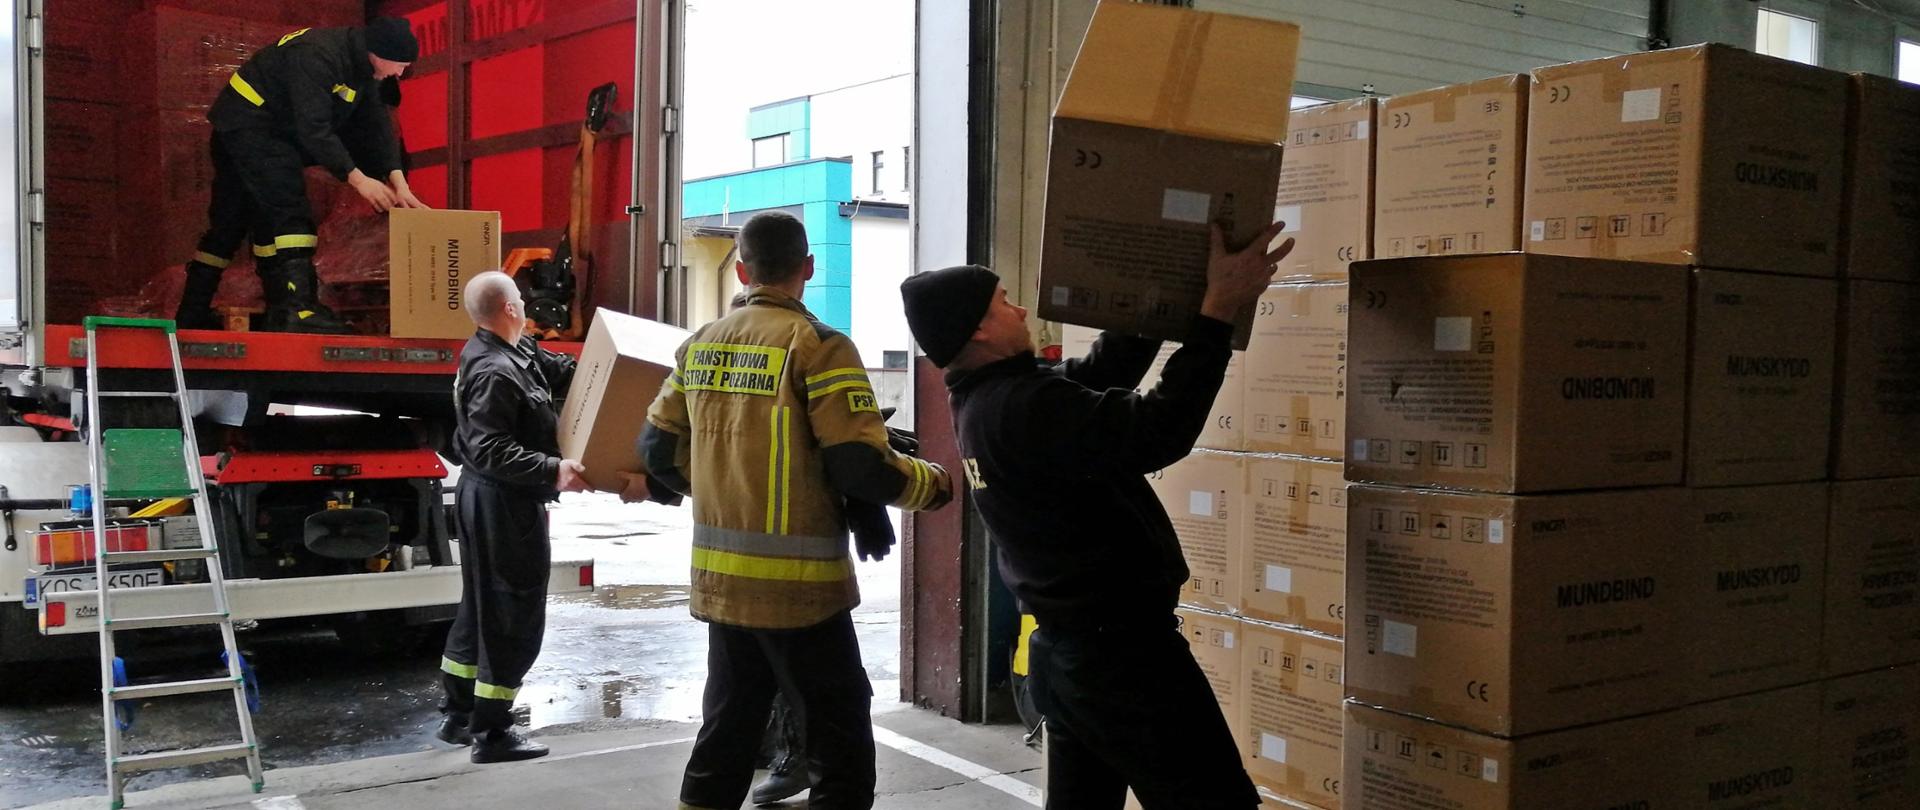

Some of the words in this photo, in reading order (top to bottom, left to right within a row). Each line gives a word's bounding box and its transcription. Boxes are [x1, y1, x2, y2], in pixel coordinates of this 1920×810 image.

[448, 239, 459, 310] MUNDBIND
[692, 347, 769, 370] PAŃSTWOWA
[1562, 377, 1655, 399] MUNDBIND
[1717, 564, 1800, 591] MUNSKYDD
[1558, 576, 1656, 608] MUNDBIND
